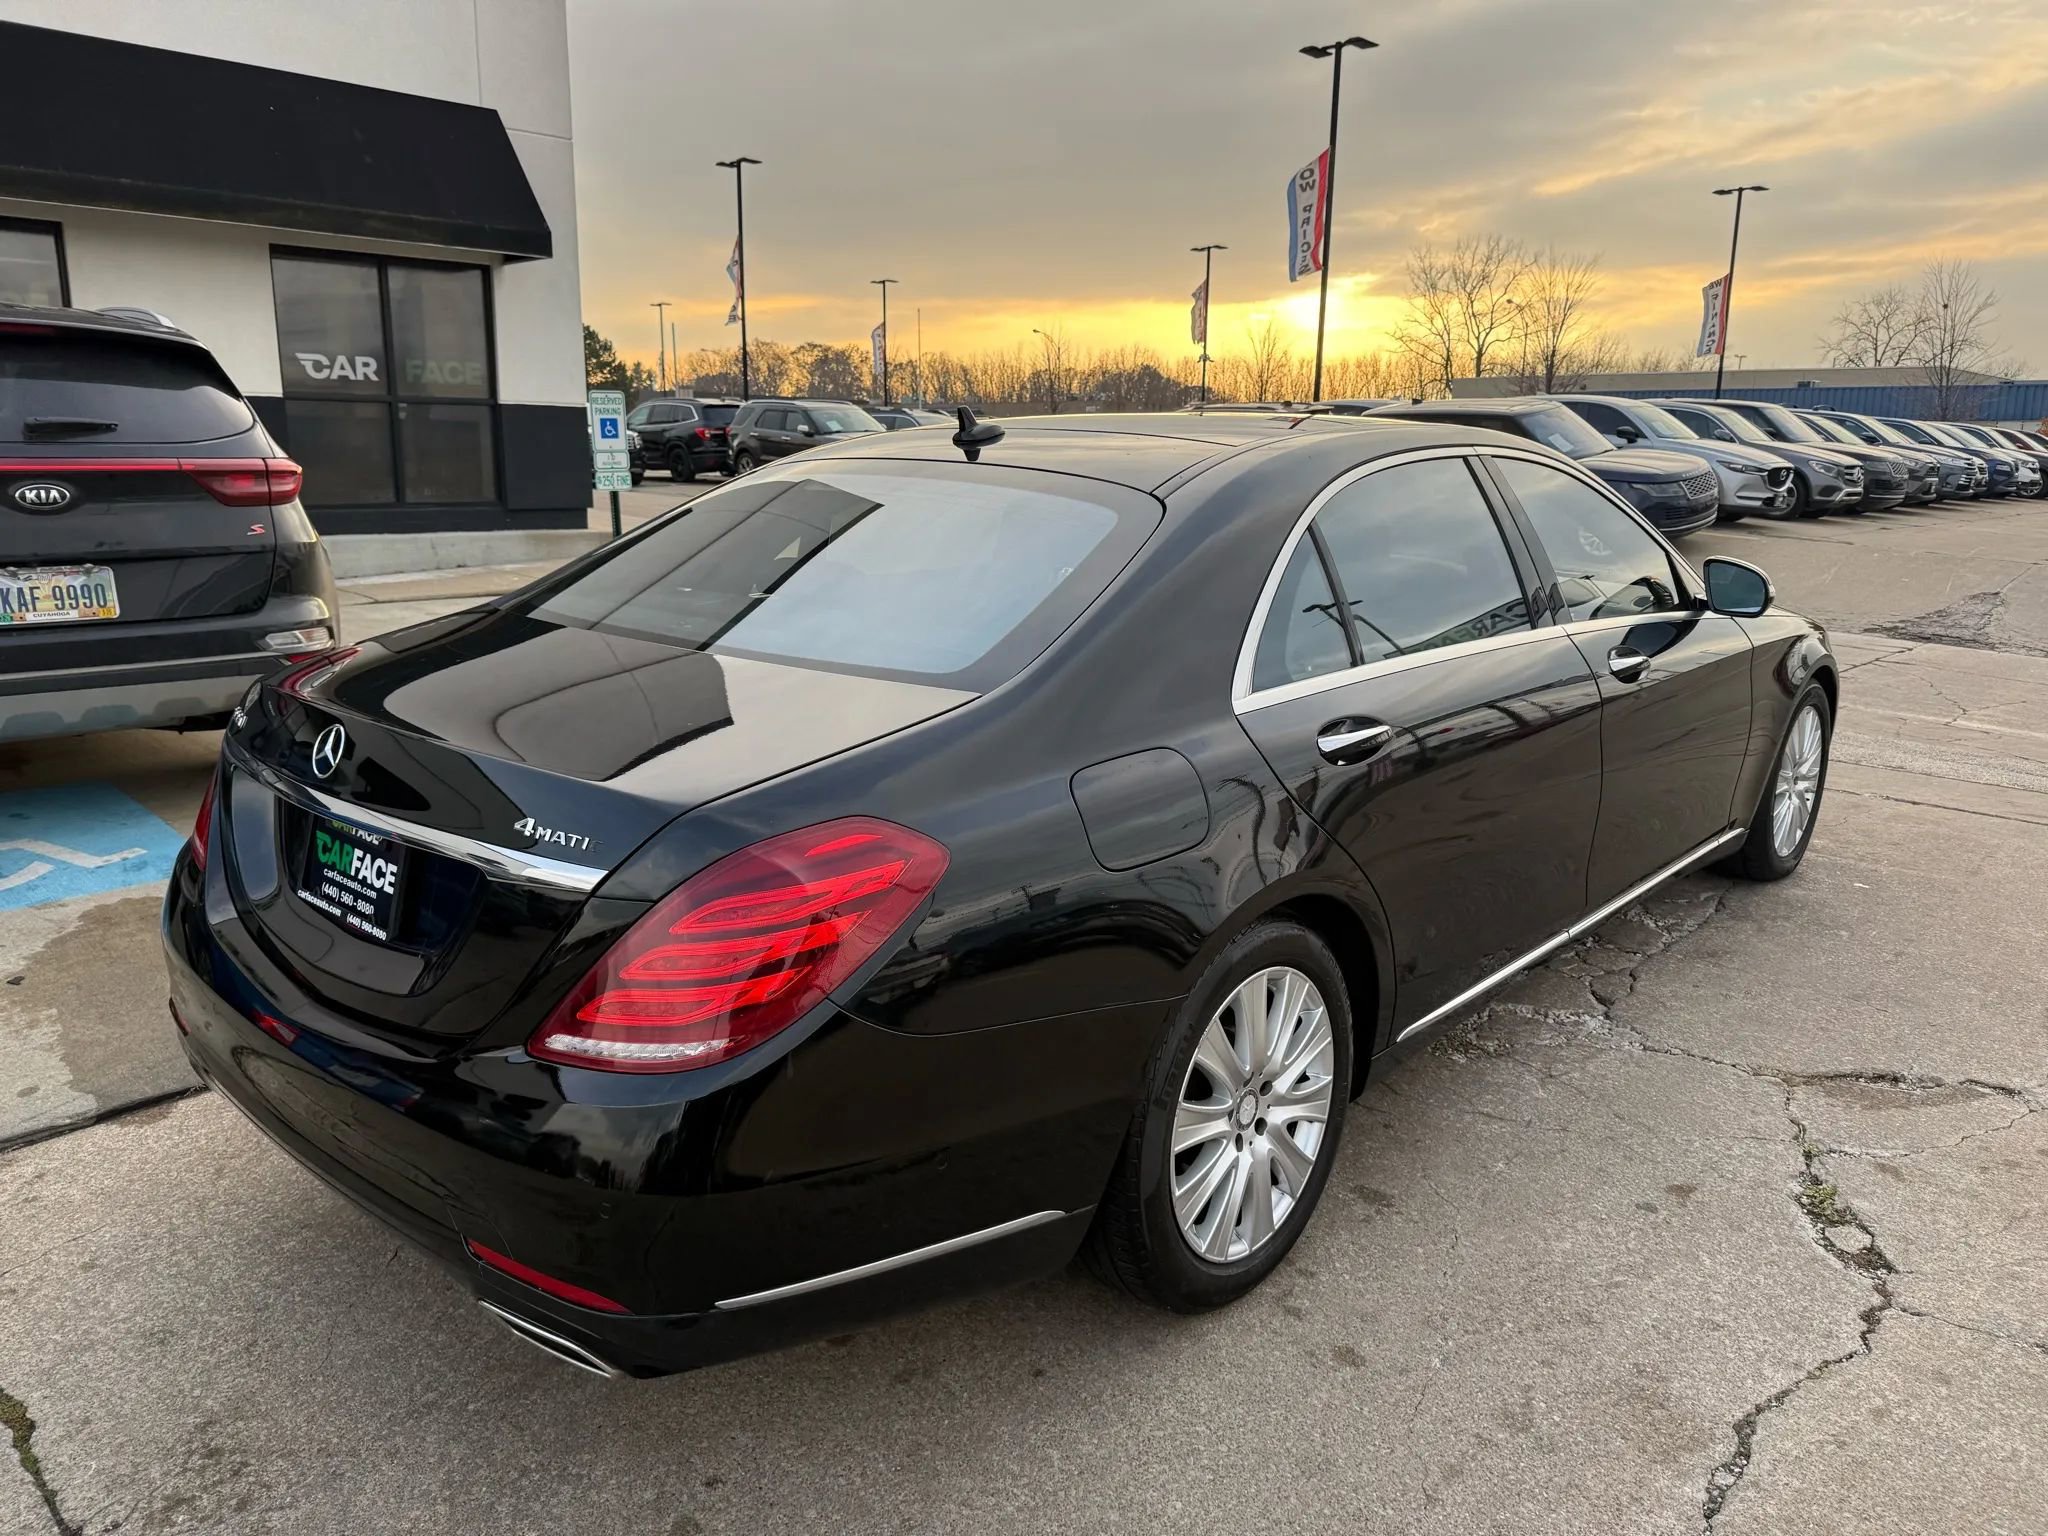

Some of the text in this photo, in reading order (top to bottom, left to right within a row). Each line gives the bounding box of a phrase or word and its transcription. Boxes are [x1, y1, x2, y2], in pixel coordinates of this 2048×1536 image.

[295, 352, 482, 385] CAR FACE
[592, 397, 622, 405] RESERVED
[594, 407, 621, 416] PARKING
[24, 489, 62, 504] KIA
[0, 583, 109, 613] KAF 9990
[315, 830, 398, 895] CARFACE
[321, 881, 340, 902] (440)
[323, 867, 377, 899] carfaceauto.com
[297, 888, 342, 917] carfaceauto.com
